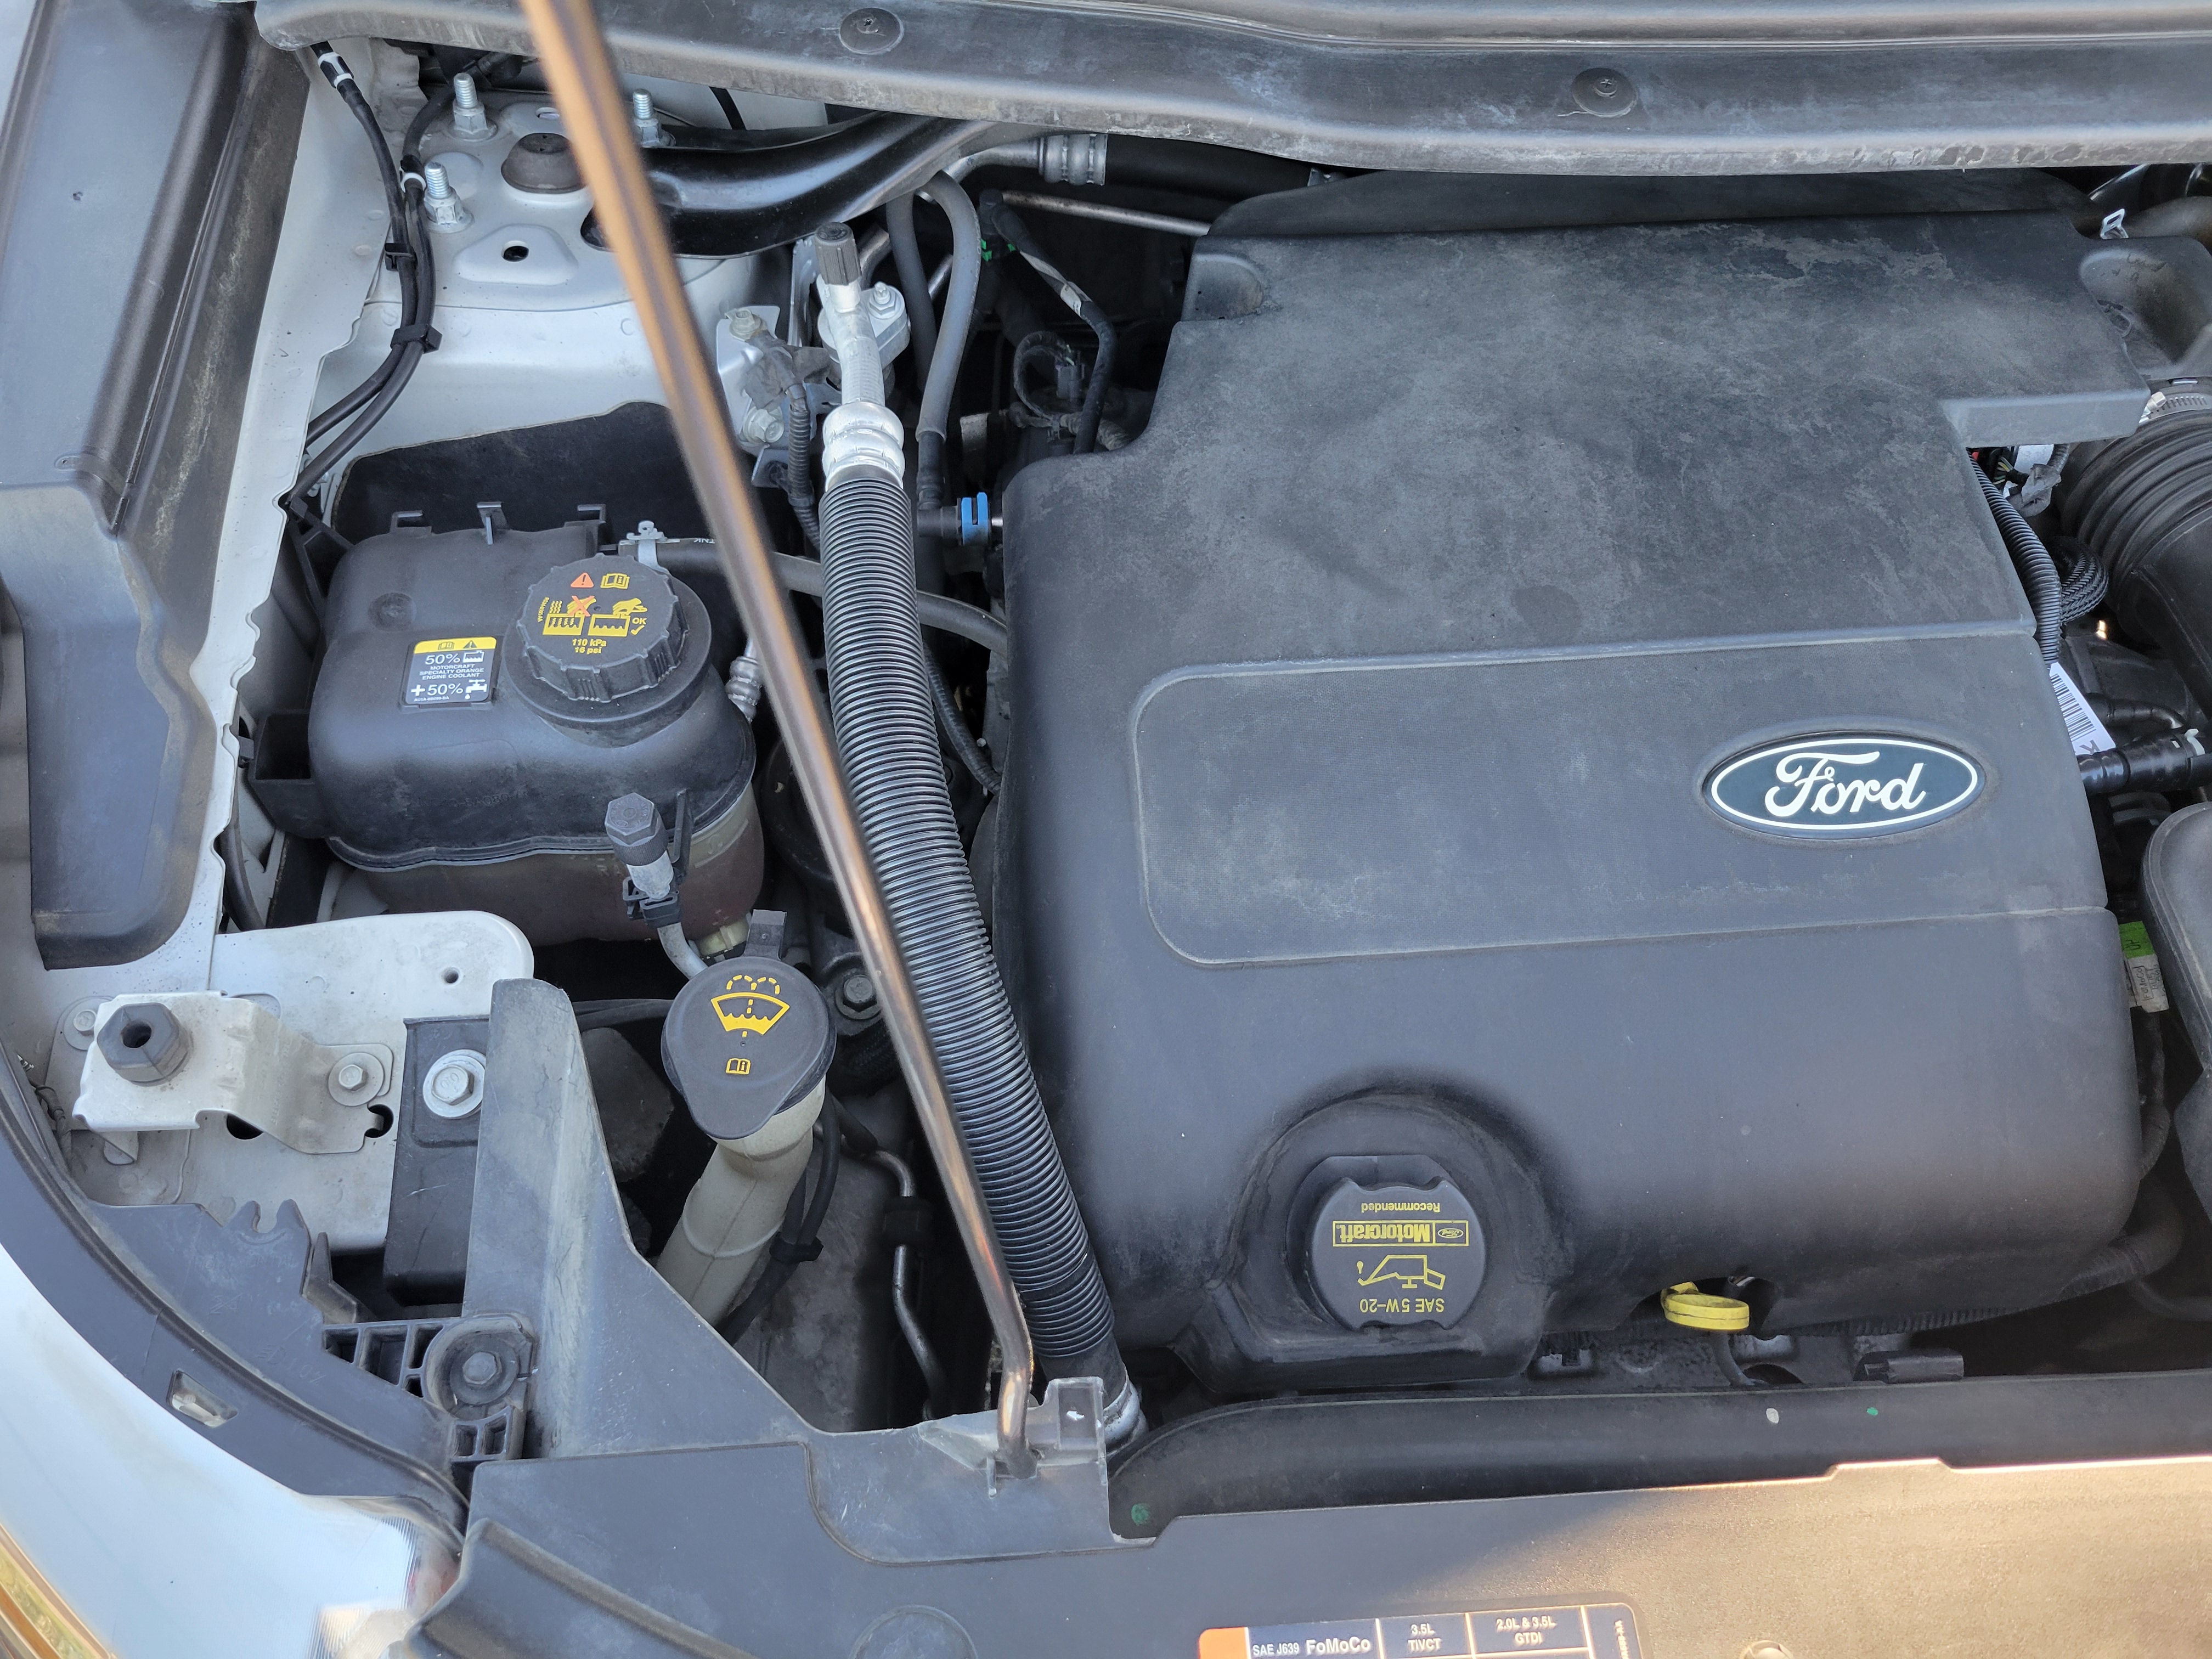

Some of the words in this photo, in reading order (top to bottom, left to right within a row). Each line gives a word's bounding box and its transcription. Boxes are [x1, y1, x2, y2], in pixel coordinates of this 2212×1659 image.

[572, 639, 588, 647] 110
[590, 639, 607, 647] kPa
[425, 653, 460, 665] 50%
[1764, 751, 1927, 817] Ford
[2136, 968, 2151, 998] FoMoCo
[1361, 1202, 1440, 1213] Recommended
[1441, 1229, 1460, 1238] Ford
[1415, 1298, 1444, 1312] SAE
[1410, 1623, 1435, 1635] 3.5L
[1496, 1617, 1520, 1632] 2.0L
[1521, 1617, 1531, 1627] &
[1532, 1616, 1556, 1628] 3.5L
[1407, 1638, 1442, 1652] TiVCT
[1514, 1631, 1543, 1645] GTDI
[1252, 1644, 1274, 1656] SAE
[1277, 1642, 1300, 1655] J639
[1306, 1636, 1372, 1655] FoMoCo
